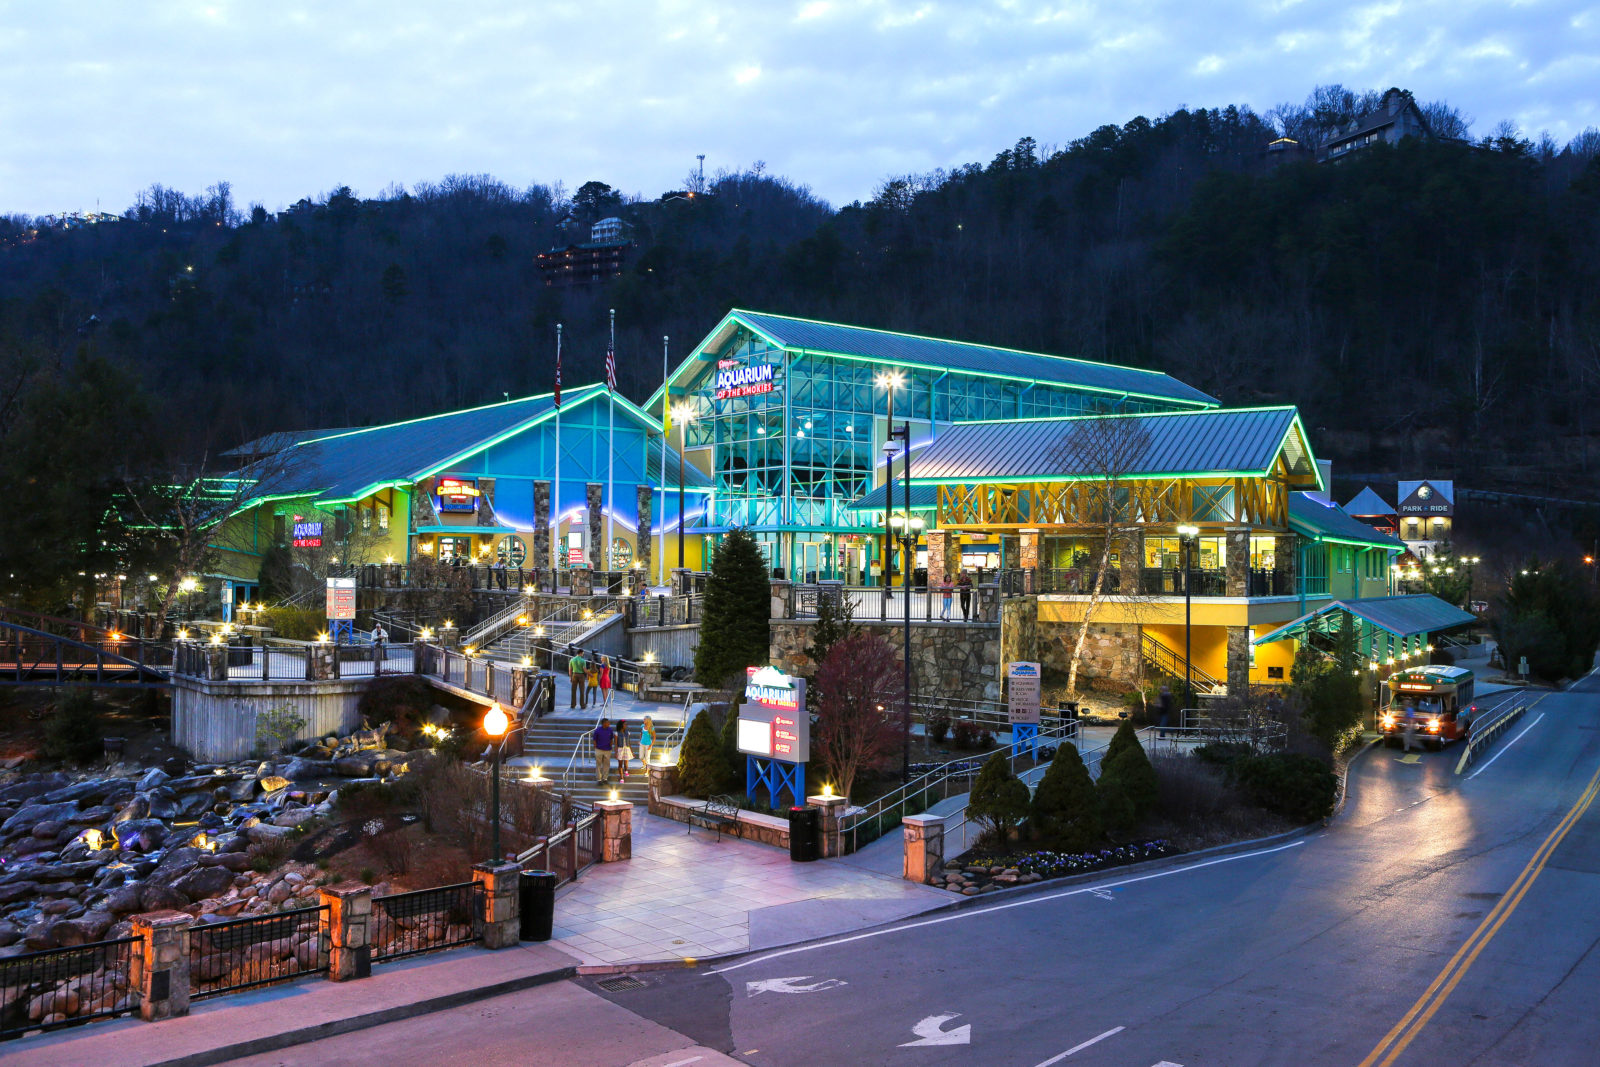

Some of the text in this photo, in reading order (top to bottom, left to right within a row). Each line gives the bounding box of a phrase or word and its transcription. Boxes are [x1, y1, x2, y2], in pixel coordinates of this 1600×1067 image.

[718, 364, 772, 390] AQUARIUM
[717, 383, 772, 399] OF THE SMOKIES
[745, 685, 794, 701] AQUARIUM
